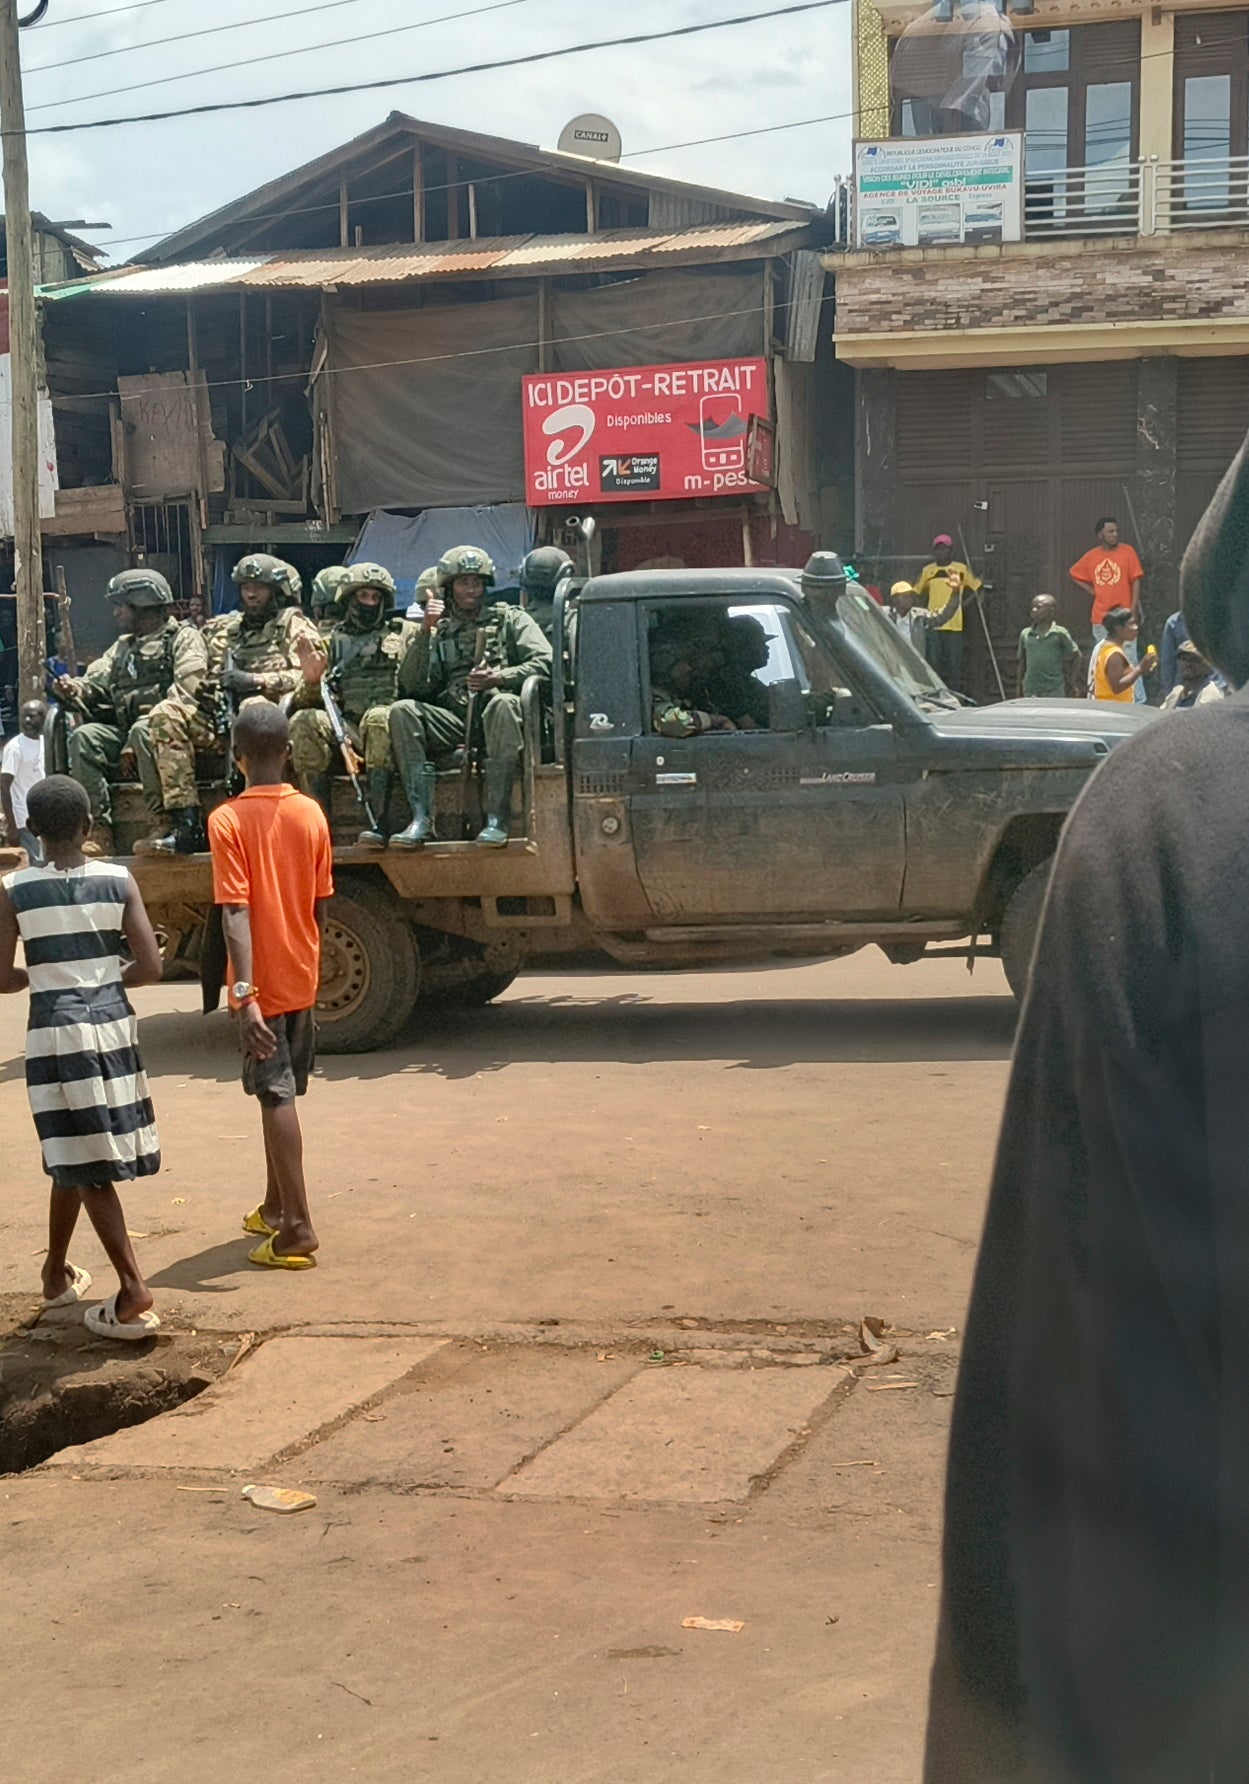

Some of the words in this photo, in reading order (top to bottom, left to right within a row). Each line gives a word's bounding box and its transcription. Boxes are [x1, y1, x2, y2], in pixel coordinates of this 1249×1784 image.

[575, 130, 608, 141] CANAL+
[906, 196, 918, 204] LA
[528, 383, 553, 407] ICI
[607, 411, 672, 430] Disponibles
[534, 461, 589, 490] airtel
[548, 489, 579, 500] money
